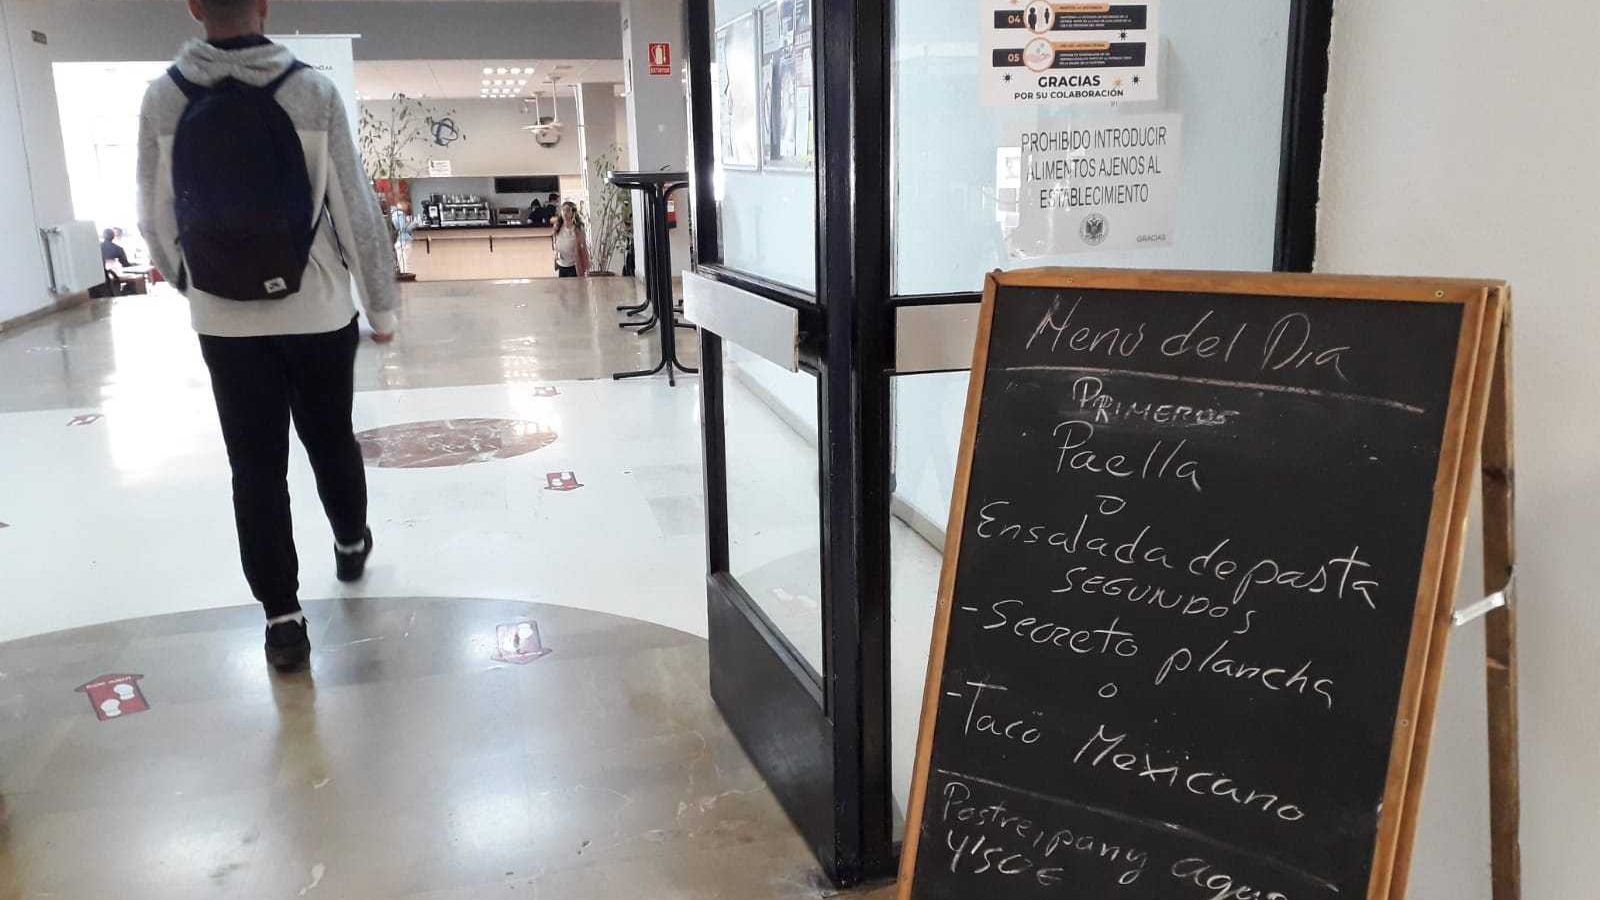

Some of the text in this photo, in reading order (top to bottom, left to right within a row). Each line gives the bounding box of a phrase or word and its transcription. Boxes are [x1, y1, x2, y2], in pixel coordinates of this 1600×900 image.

[1007, 14, 1021, 25] 04
[1007, 53, 1021, 63] 05
[1014, 88, 1124, 100] POR SU COLABORACIÓN
[1038, 75, 1101, 88] GRACIAS
[1020, 126, 1167, 152] PROHIBIDO INTRODUCIR
[1026, 154, 1162, 181] ALIMENTOS AJENOS AL
[1039, 183, 1150, 209] ESTABLECIMIENTO
[1160, 310, 1247, 363] del
[1053, 420, 1202, 493] Paella
[977, 500, 1175, 570] Ensalada
[1154, 640, 1337, 709] plancha
[1073, 723, 1306, 822] Mexicano
